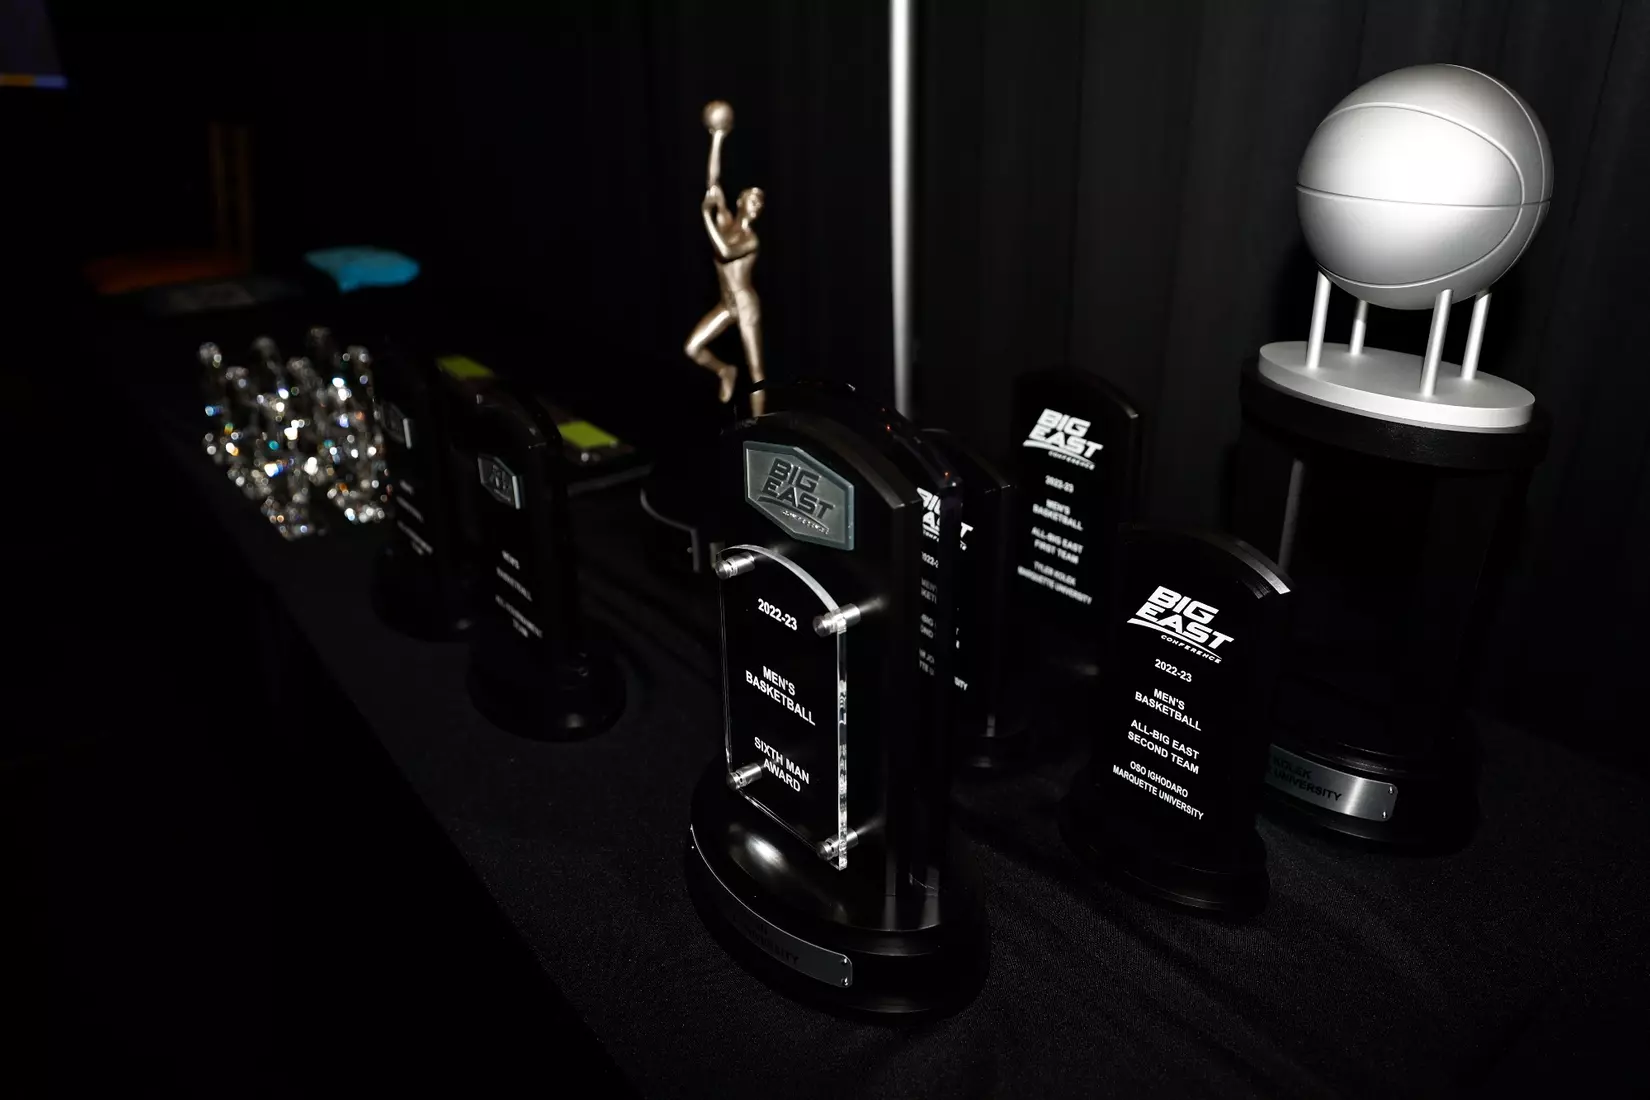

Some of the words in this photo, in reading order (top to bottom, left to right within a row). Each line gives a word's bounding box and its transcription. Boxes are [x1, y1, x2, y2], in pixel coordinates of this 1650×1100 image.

[1028, 422, 1104, 458] EAST
[1036, 408, 1091, 438] BIG
[769, 458, 822, 493] BIG
[761, 476, 835, 519] EAST
[1032, 503, 1083, 531] BASKETBALL
[757, 598, 798, 631] 2022-23
[1147, 585, 1219, 625] BIG
[1135, 601, 1235, 650] EAST
[1160, 633, 1222, 664] CONFERENCE
[763, 665, 796, 696] MEN'S
[1154, 658, 1193, 683] 2022-23
[745, 670, 816, 726] BASKETBALL
[1135, 691, 1202, 732] BASKETBALL
[1153, 688, 1186, 711] MEN'S
[1127, 730, 1168, 759] SECOND
[1170, 753, 1200, 775] TEAM
[1130, 719, 1170, 747] ALL-BIG
[1171, 739, 1200, 760] EAST
[754, 736, 784, 766] SIXTH
[785, 756, 810, 785] MAN
[763, 758, 802, 793] AWARD
[1112, 764, 1158, 796] MARQUETTE
[1159, 790, 1205, 821] UNIVERSITY
[1129, 760, 1147, 776] OSO
[1147, 769, 1189, 799] IGHODARO
[1274, 767, 1343, 801] UNIVERSITY
